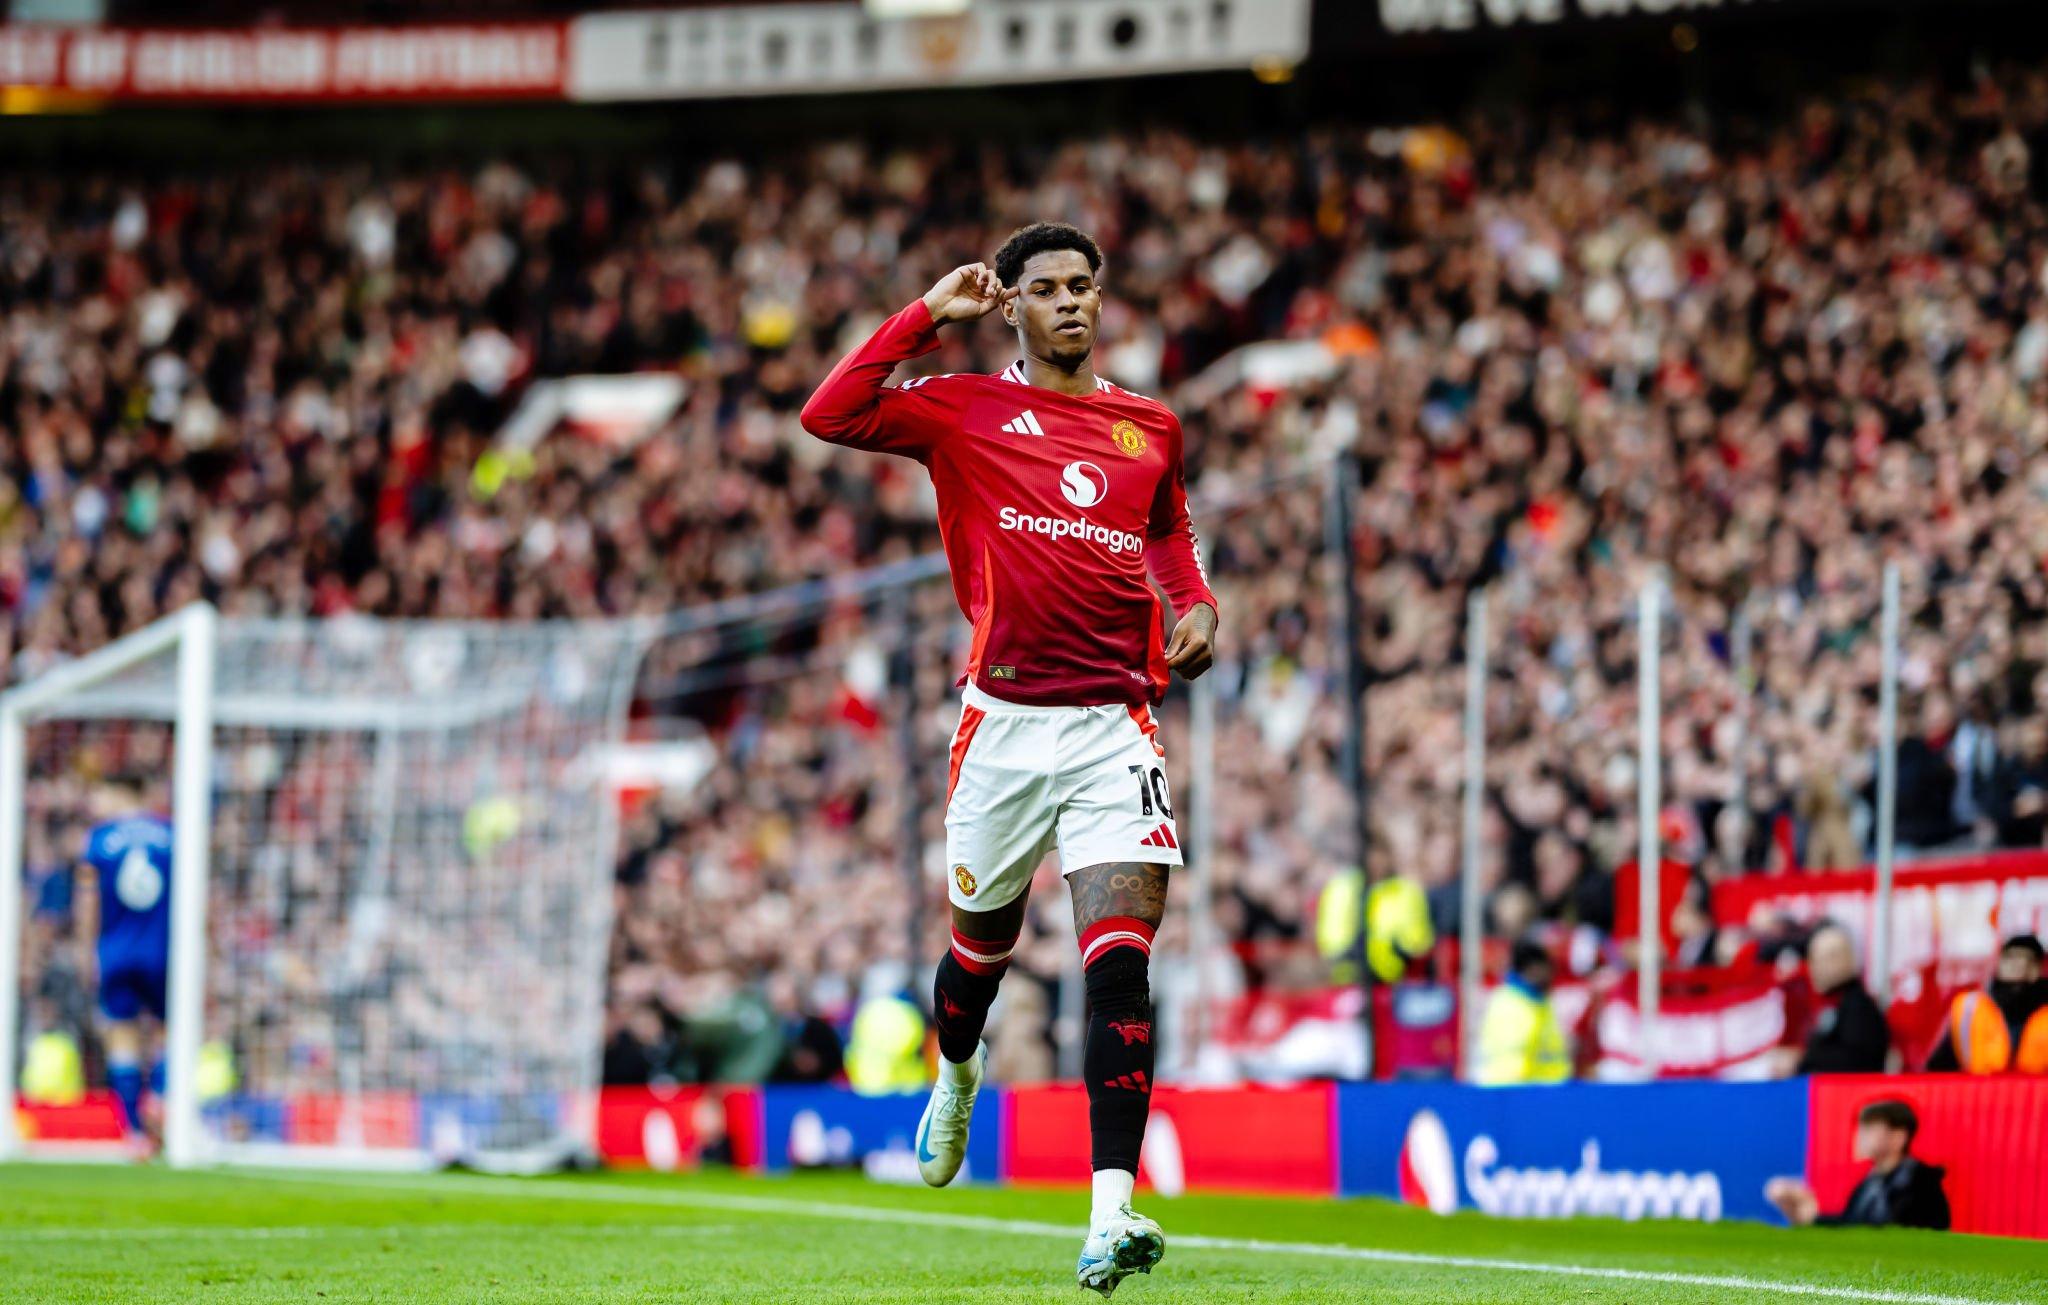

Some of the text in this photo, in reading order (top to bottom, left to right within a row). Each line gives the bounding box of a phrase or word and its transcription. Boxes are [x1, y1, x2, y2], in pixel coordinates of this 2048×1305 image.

[999, 507, 1143, 554] Snapdragon
[1128, 765, 1174, 819] 10
[116, 846, 163, 912] 6
